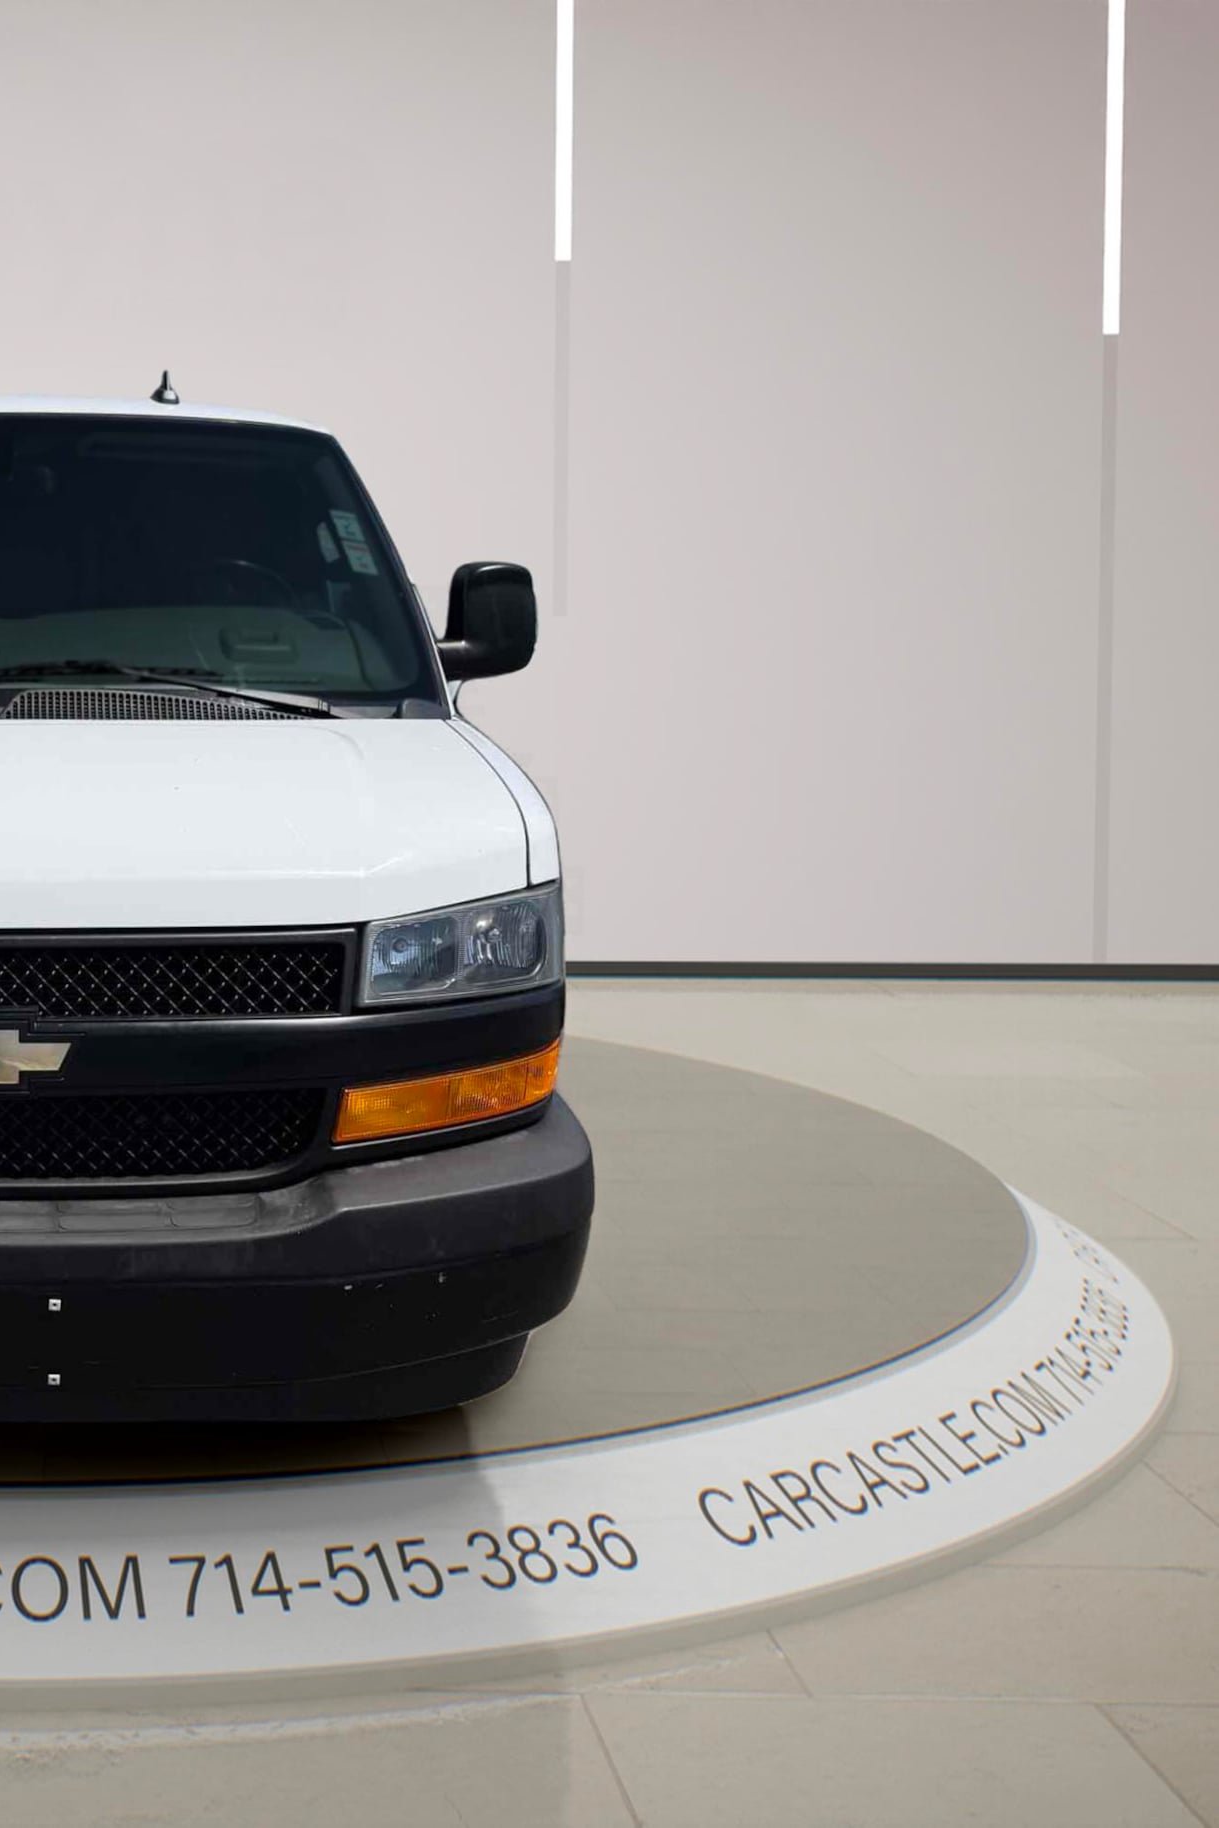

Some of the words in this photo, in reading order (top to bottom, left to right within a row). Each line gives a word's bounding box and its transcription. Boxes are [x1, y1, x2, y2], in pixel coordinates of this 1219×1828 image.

[697, 1371, 1072, 1548] CARCASTLE.COM
[1033, 1278, 1130, 1405] 714-515-
[167, 1513, 639, 1618] 714-515-3836
